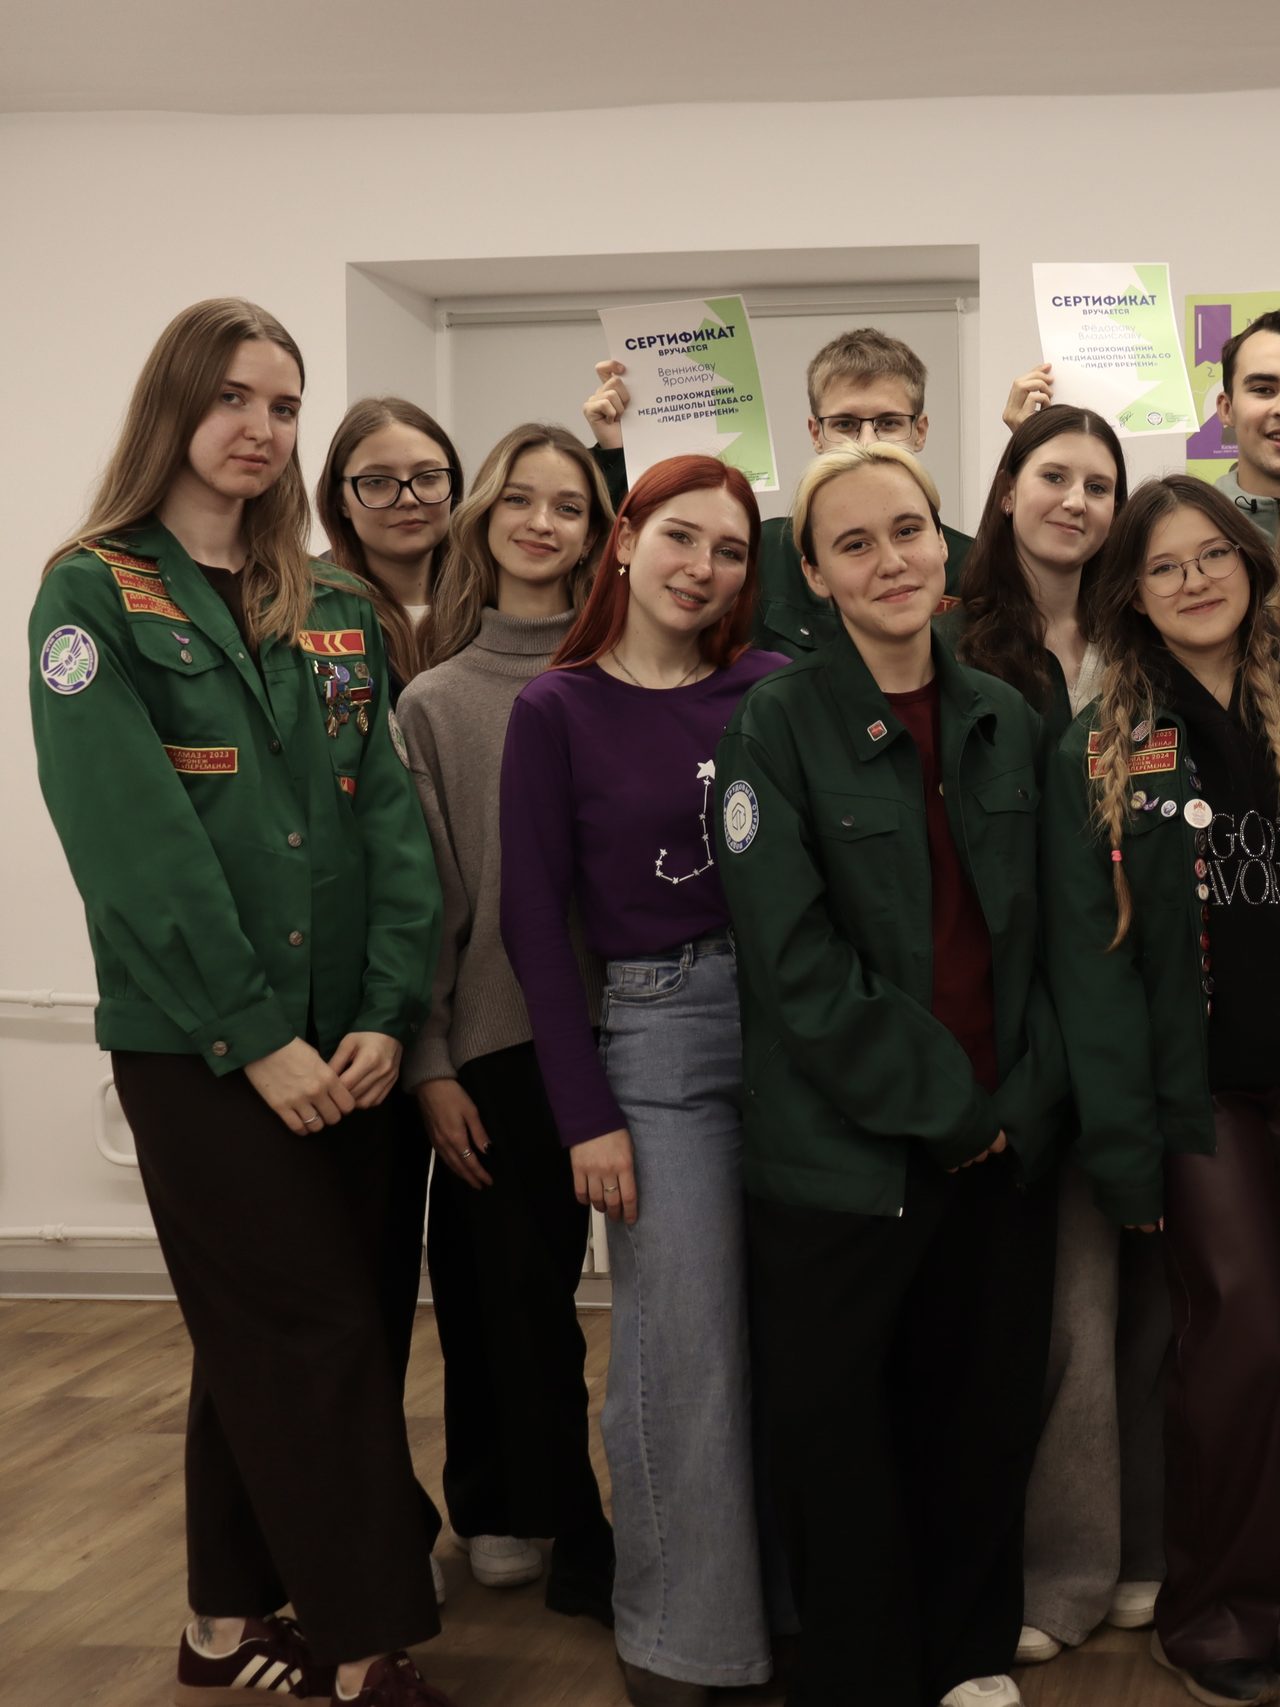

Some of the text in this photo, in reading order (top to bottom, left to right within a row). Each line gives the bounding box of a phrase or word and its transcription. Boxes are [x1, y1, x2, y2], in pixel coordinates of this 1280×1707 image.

[1052, 295, 1157, 307] СЕРТИФИКАТ
[1082, 308, 1130, 316] ВРУЧАЕТСЯ
[625, 325, 736, 351] СЕРТИФИКАТ
[658, 344, 708, 357] ВРУЧАЕТСЯ
[1062, 354, 1127, 362] МЕДИАШКОЛЫ
[657, 362, 716, 377] Венникову
[662, 373, 715, 387] Яромиру
[656, 387, 735, 404] О ПРОХОЖДЕНИИ
[638, 394, 753, 416] МЕДИАШКОЛЫ ШТАБА СО
[657, 407, 739, 424] «ЛИДЕР ВРЕМЕНИ»
